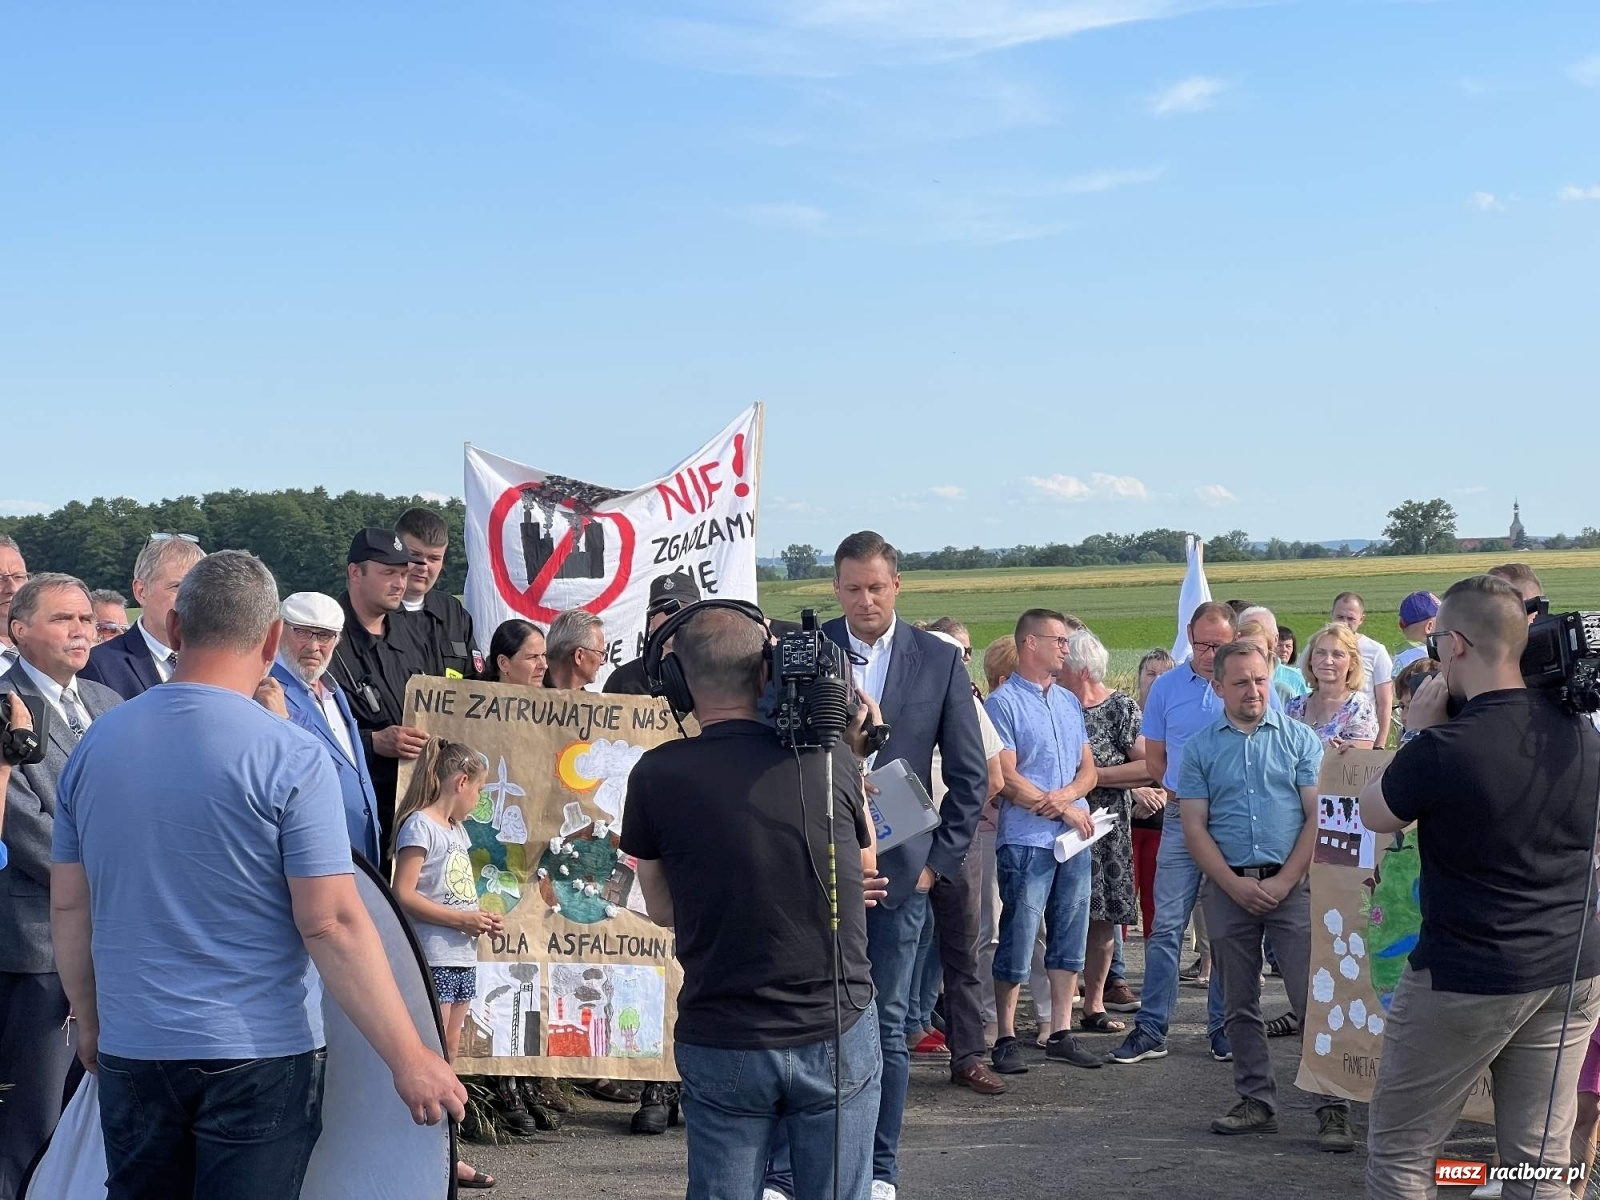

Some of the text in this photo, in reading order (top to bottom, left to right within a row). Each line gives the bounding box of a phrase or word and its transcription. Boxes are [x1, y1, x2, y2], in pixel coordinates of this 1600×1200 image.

[652, 509, 755, 564] ZGADZAMY
[673, 560, 718, 593] IĘ
[414, 689, 457, 715] NIE
[465, 693, 623, 740] ZATRUWAJCIE
[1342, 764, 1360, 786] NIE
[491, 933, 529, 955] DLA
[1343, 1052, 1381, 1079] PAMIĘTA
